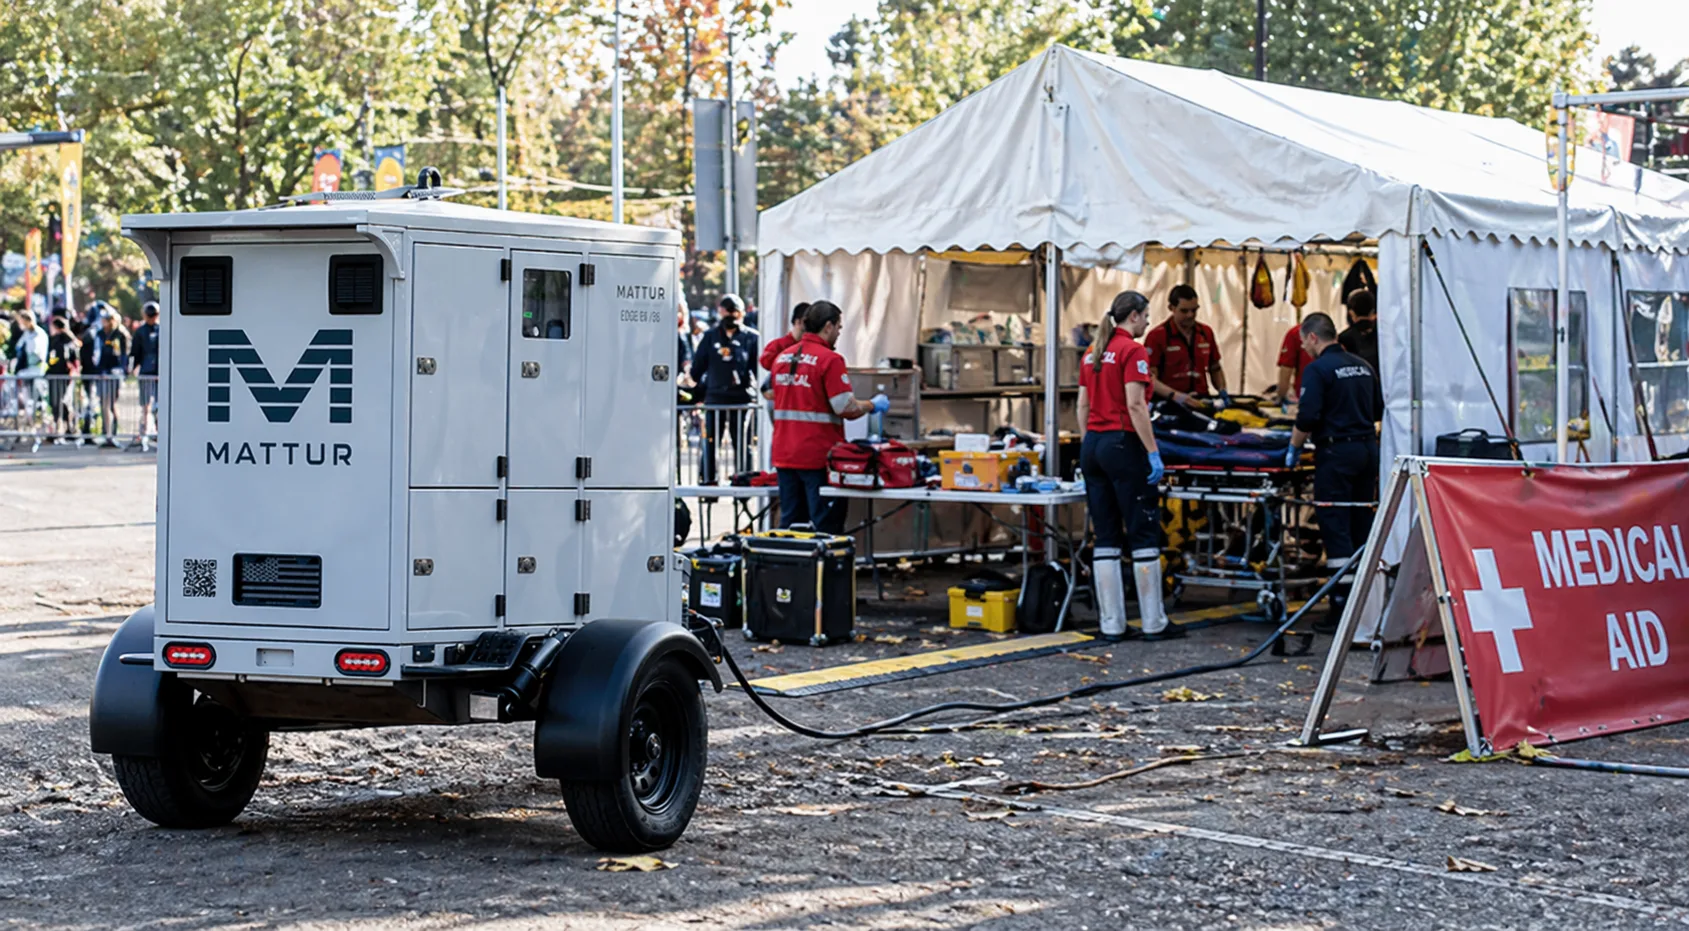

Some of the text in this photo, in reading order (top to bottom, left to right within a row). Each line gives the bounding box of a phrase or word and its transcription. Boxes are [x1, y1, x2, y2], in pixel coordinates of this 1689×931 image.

[616, 285, 665, 300] MATTUR
[208, 329, 353, 423] M
[206, 442, 352, 466] MATTUR
[1531, 525, 1689, 588] MEDICAL
[1606, 610, 1669, 671] AID
